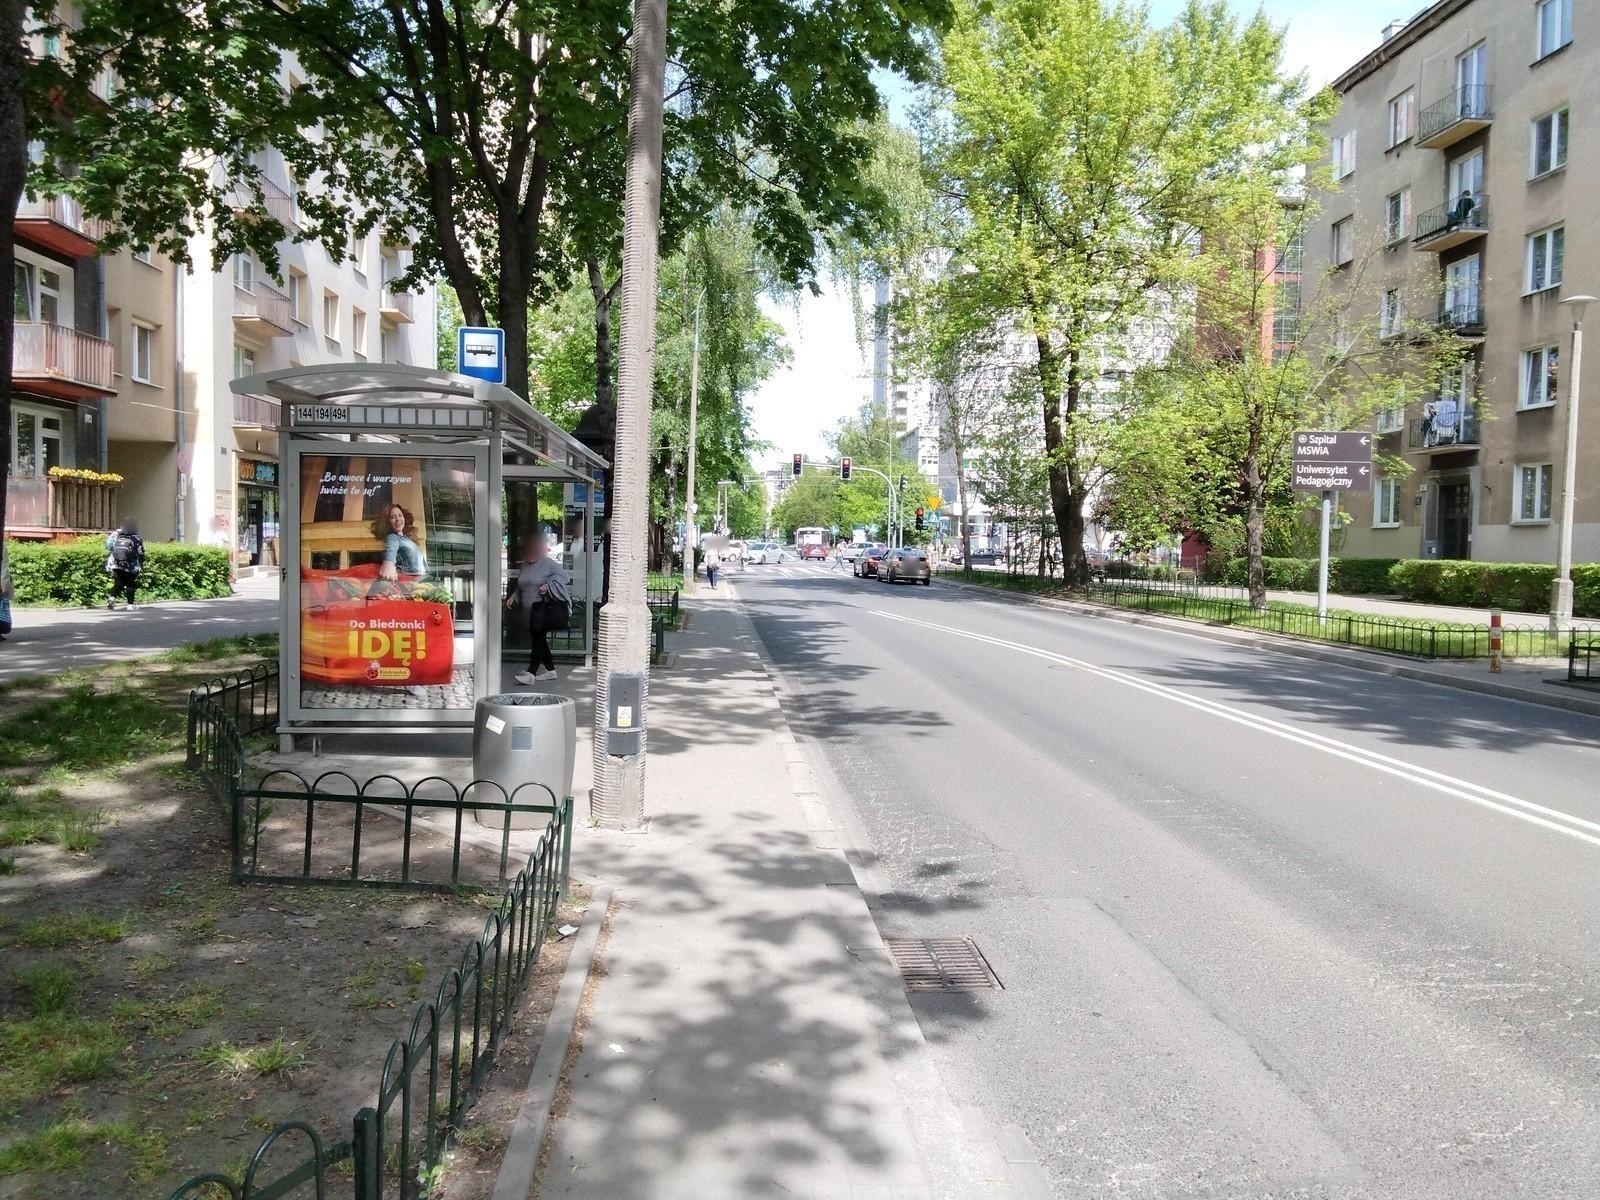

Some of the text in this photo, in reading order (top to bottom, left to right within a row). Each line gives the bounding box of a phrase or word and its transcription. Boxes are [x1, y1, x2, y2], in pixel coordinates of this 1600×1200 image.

[298, 407, 347, 420] 144 194 494
[1309, 434, 1337, 445] Szpital
[1297, 446, 1330, 456] MSWiA
[1296, 464, 1348, 476] Uniwersytet
[338, 474, 364, 483] owoce
[372, 475, 412, 485] warzywa
[1296, 475, 1353, 488] Pedagogiczny
[350, 486, 361, 496] tu
[349, 618, 426, 629] Do Biedronki
[348, 630, 427, 667] IDĘ!
